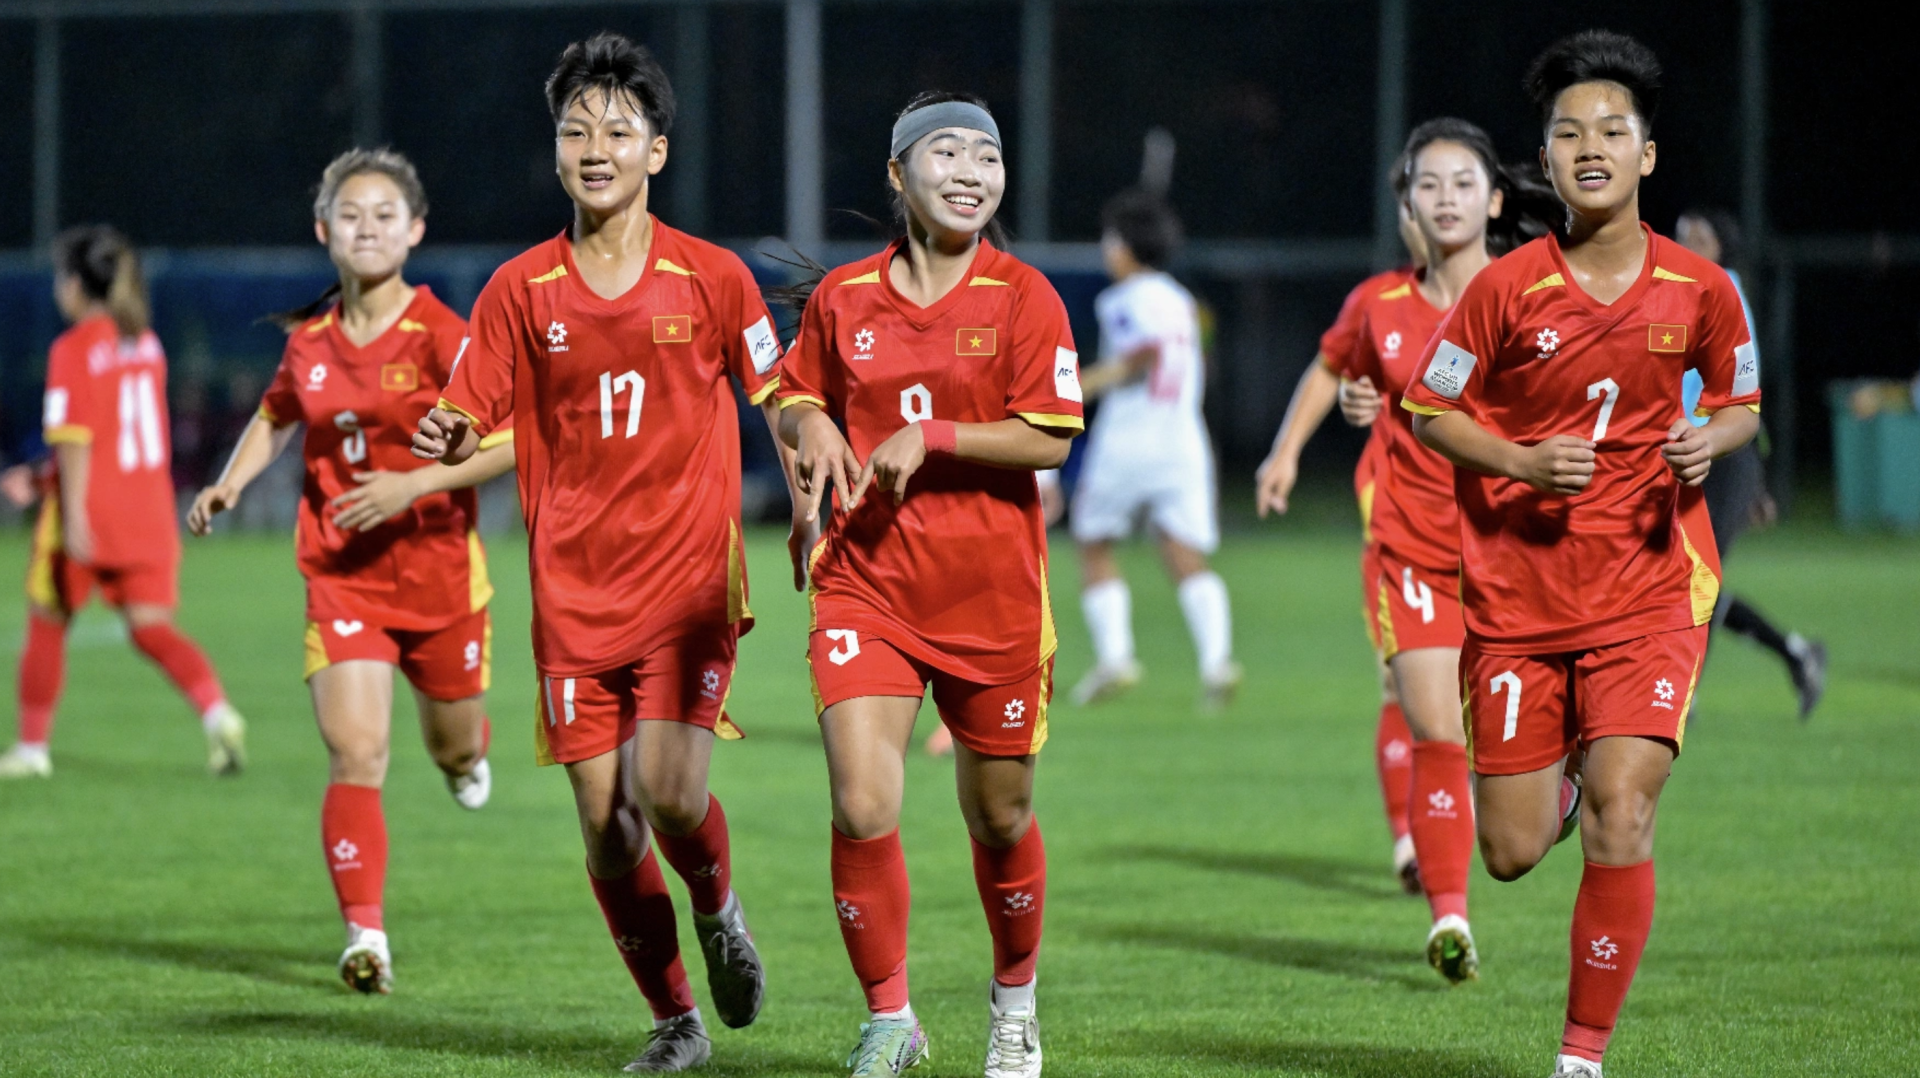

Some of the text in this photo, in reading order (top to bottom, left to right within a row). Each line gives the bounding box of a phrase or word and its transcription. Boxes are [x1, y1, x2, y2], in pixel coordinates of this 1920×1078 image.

[754, 334, 771, 355] AFC
[599, 369, 645, 440] 17
[1587, 377, 1620, 442] 7
[1403, 568, 1435, 625] 4
[1490, 670, 1523, 743] 7
